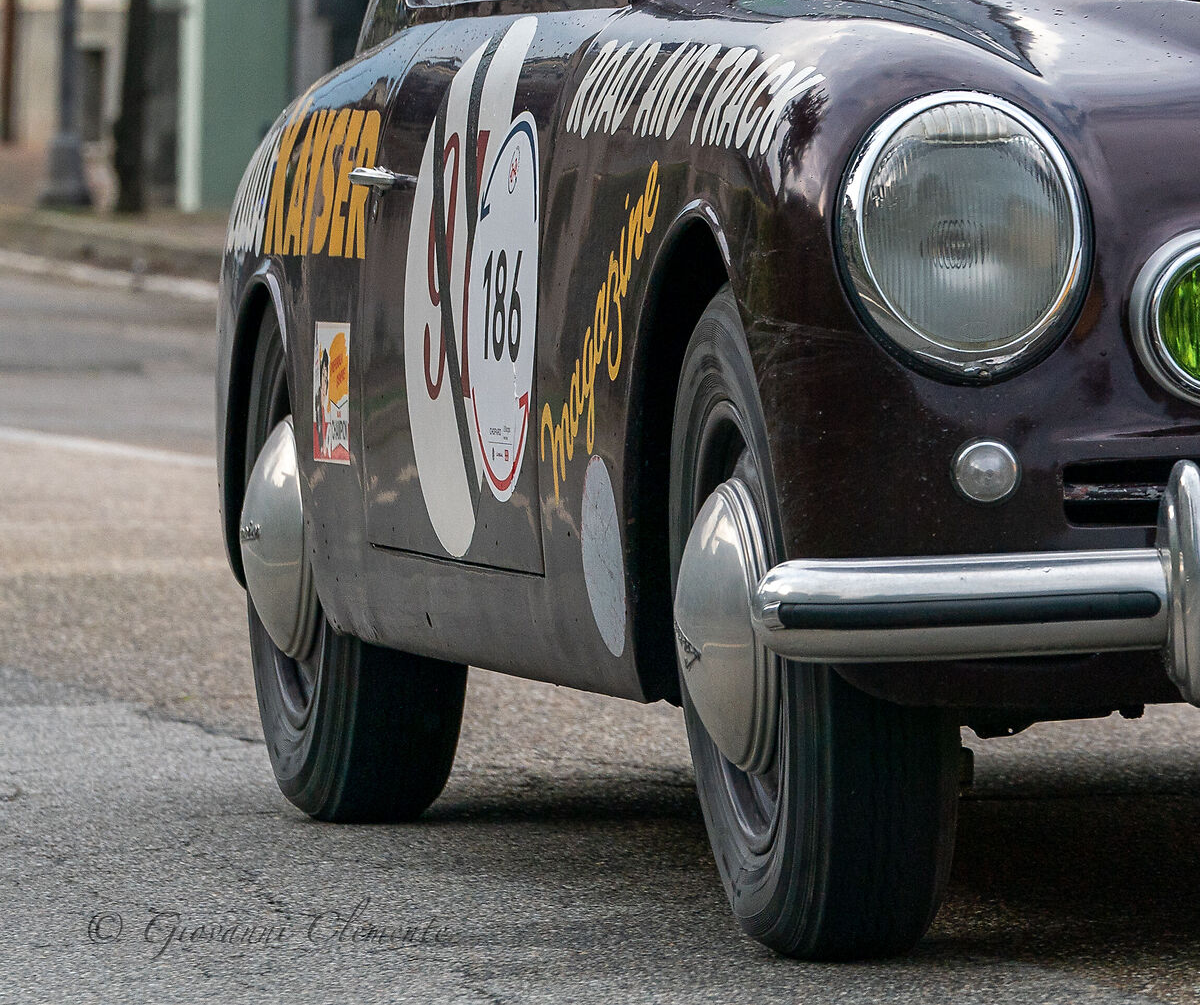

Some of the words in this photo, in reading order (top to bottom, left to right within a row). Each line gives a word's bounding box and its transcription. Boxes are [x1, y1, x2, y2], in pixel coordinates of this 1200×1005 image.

[566, 38, 662, 140] ROAD
[632, 38, 722, 141] AND
[690, 46, 827, 159] TRACK
[263, 96, 382, 260] KAYSER
[482, 249, 523, 363] 186
